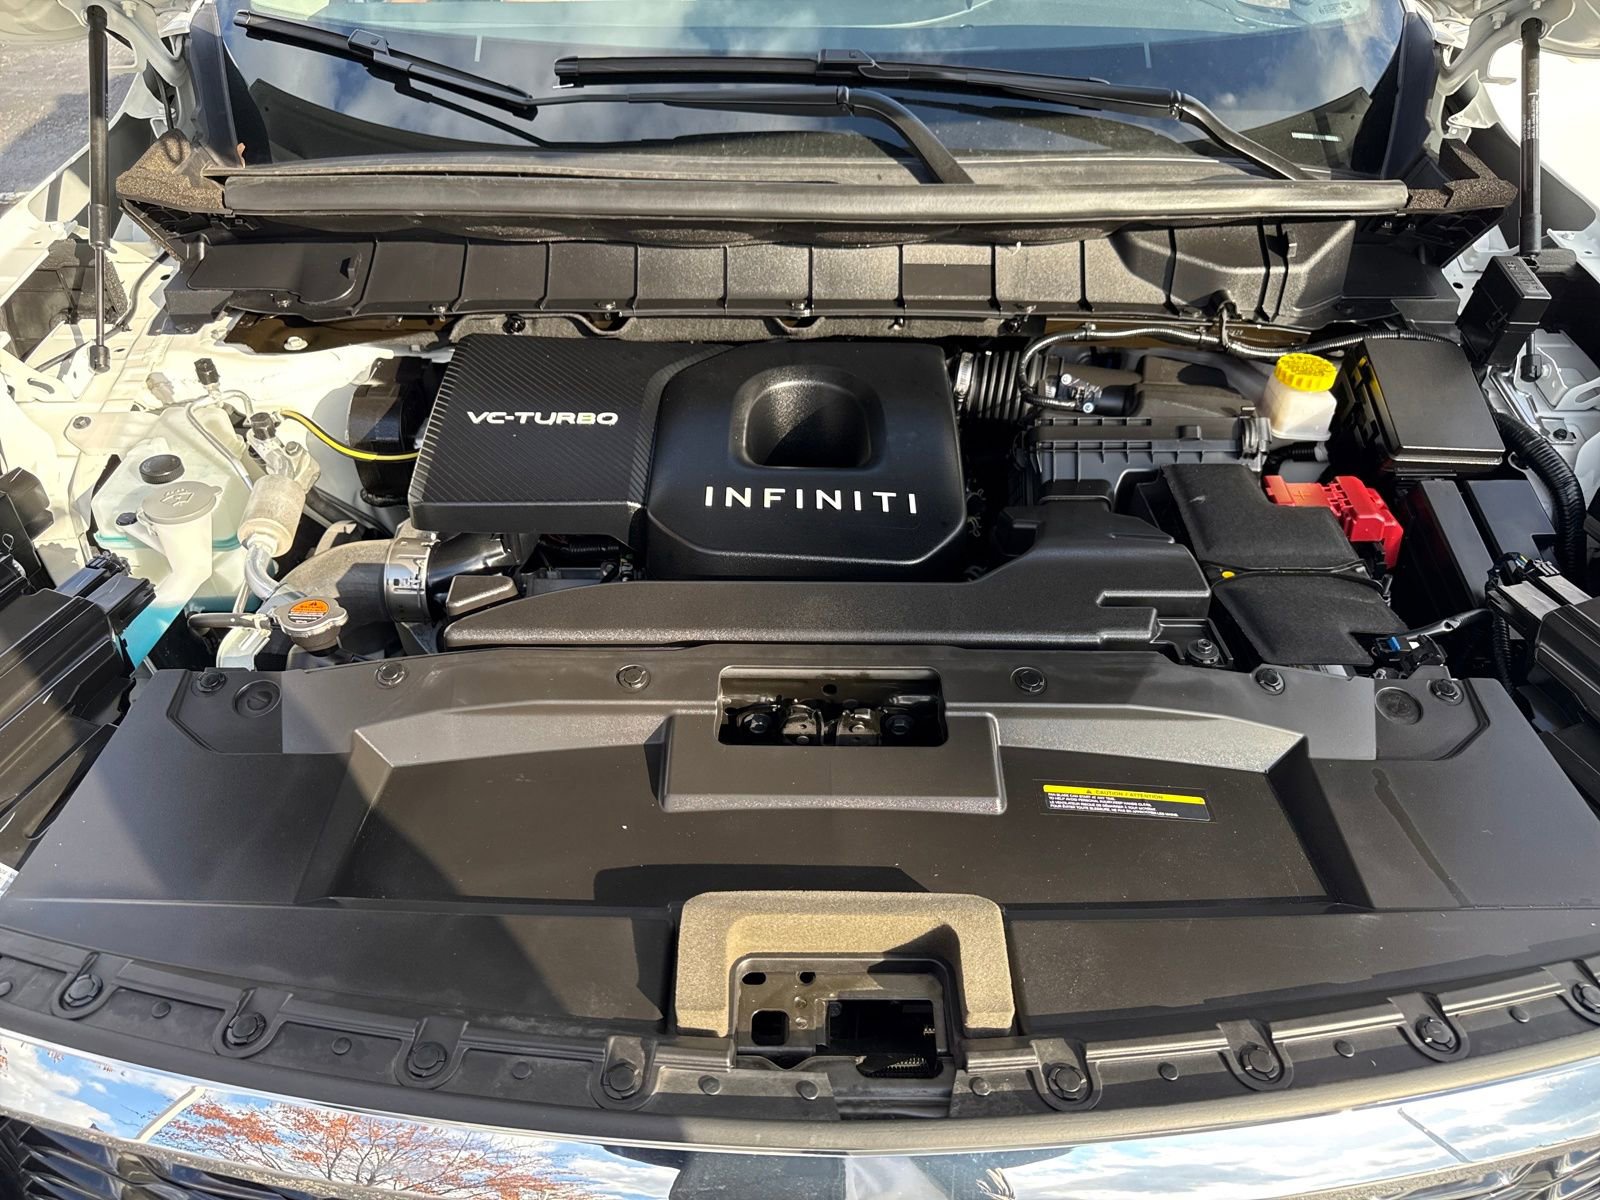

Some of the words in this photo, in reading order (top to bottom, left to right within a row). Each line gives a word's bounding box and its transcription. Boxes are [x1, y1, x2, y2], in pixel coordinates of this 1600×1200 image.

[466, 411, 619, 426] VC-TURBO
[704, 486, 918, 514] INFINITI
[1095, 789, 1124, 797] CAUTION
[1129, 792, 1164, 800] ATTENTION
